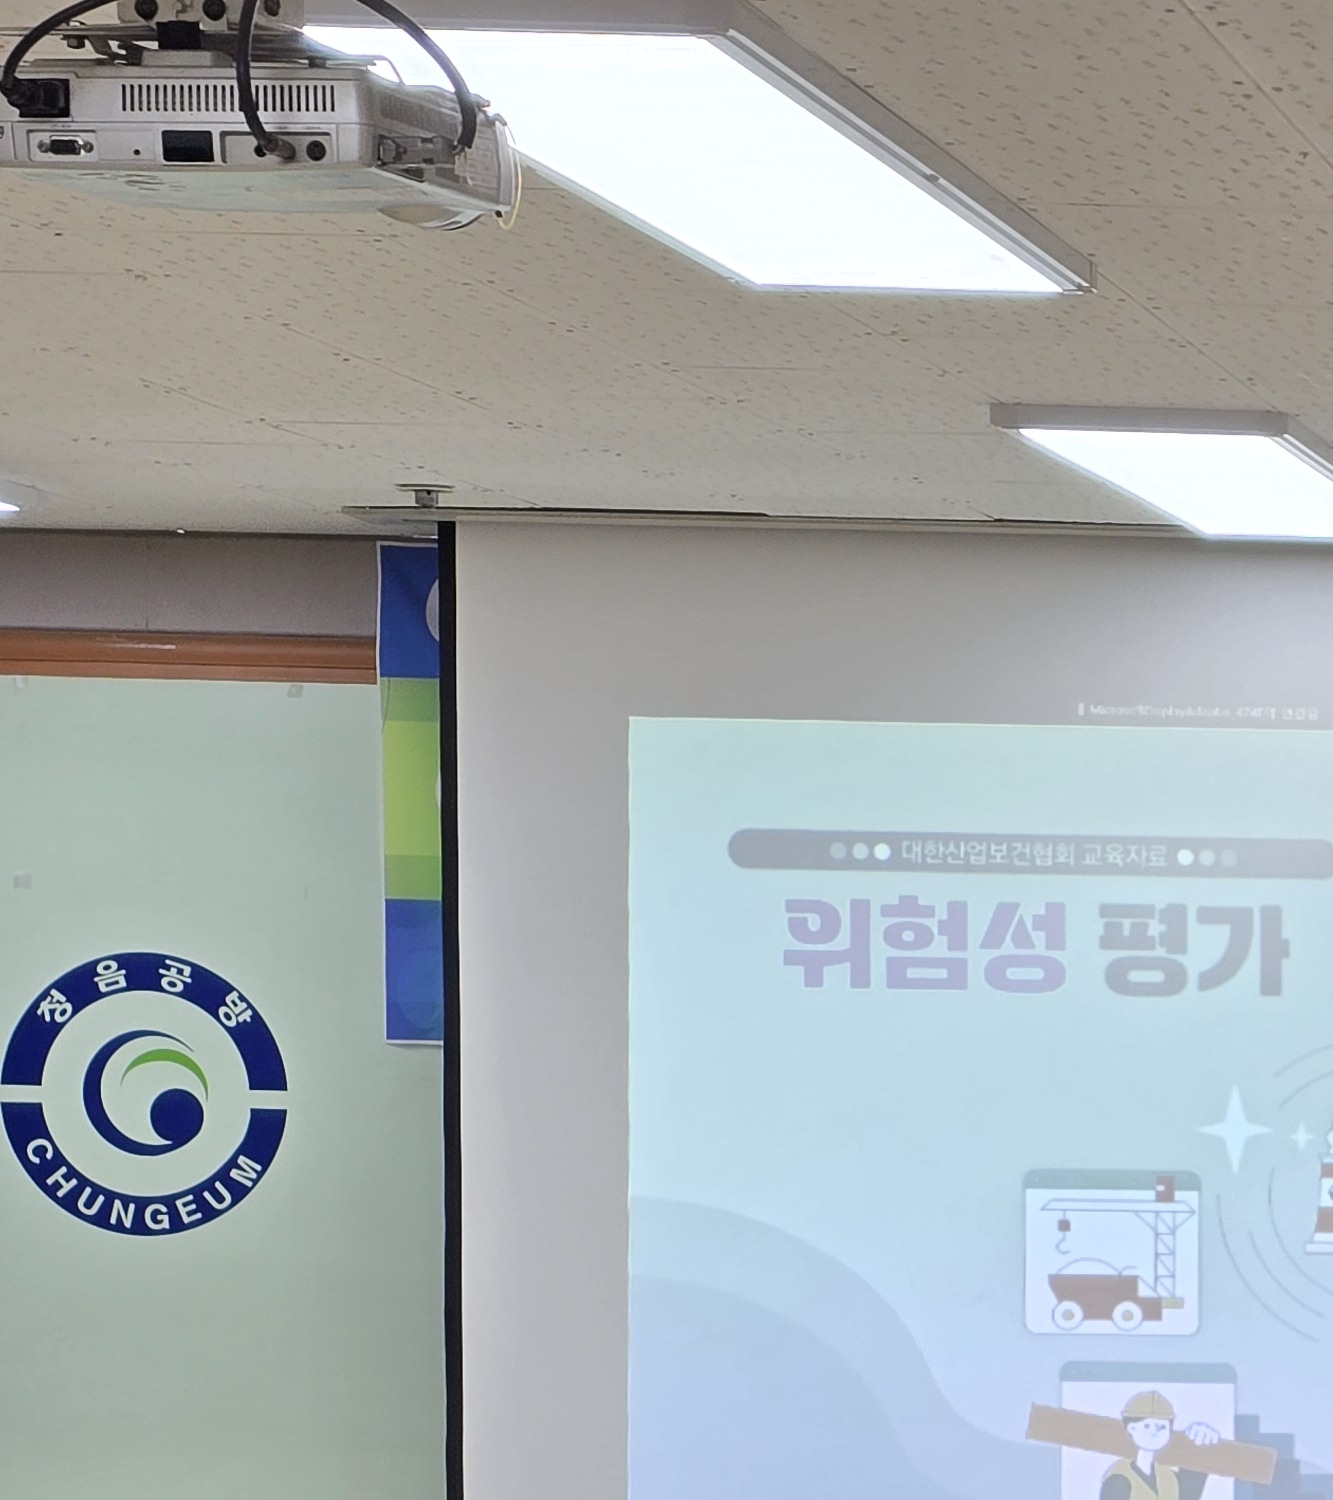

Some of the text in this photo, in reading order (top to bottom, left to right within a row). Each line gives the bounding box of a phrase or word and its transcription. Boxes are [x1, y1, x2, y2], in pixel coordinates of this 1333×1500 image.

[901, 839, 1168, 869] 대한산업보건협회 교육자료
[783, 895, 1291, 997] 위험성 평가
[26, 1138, 262, 1230] CHUNGEUM
